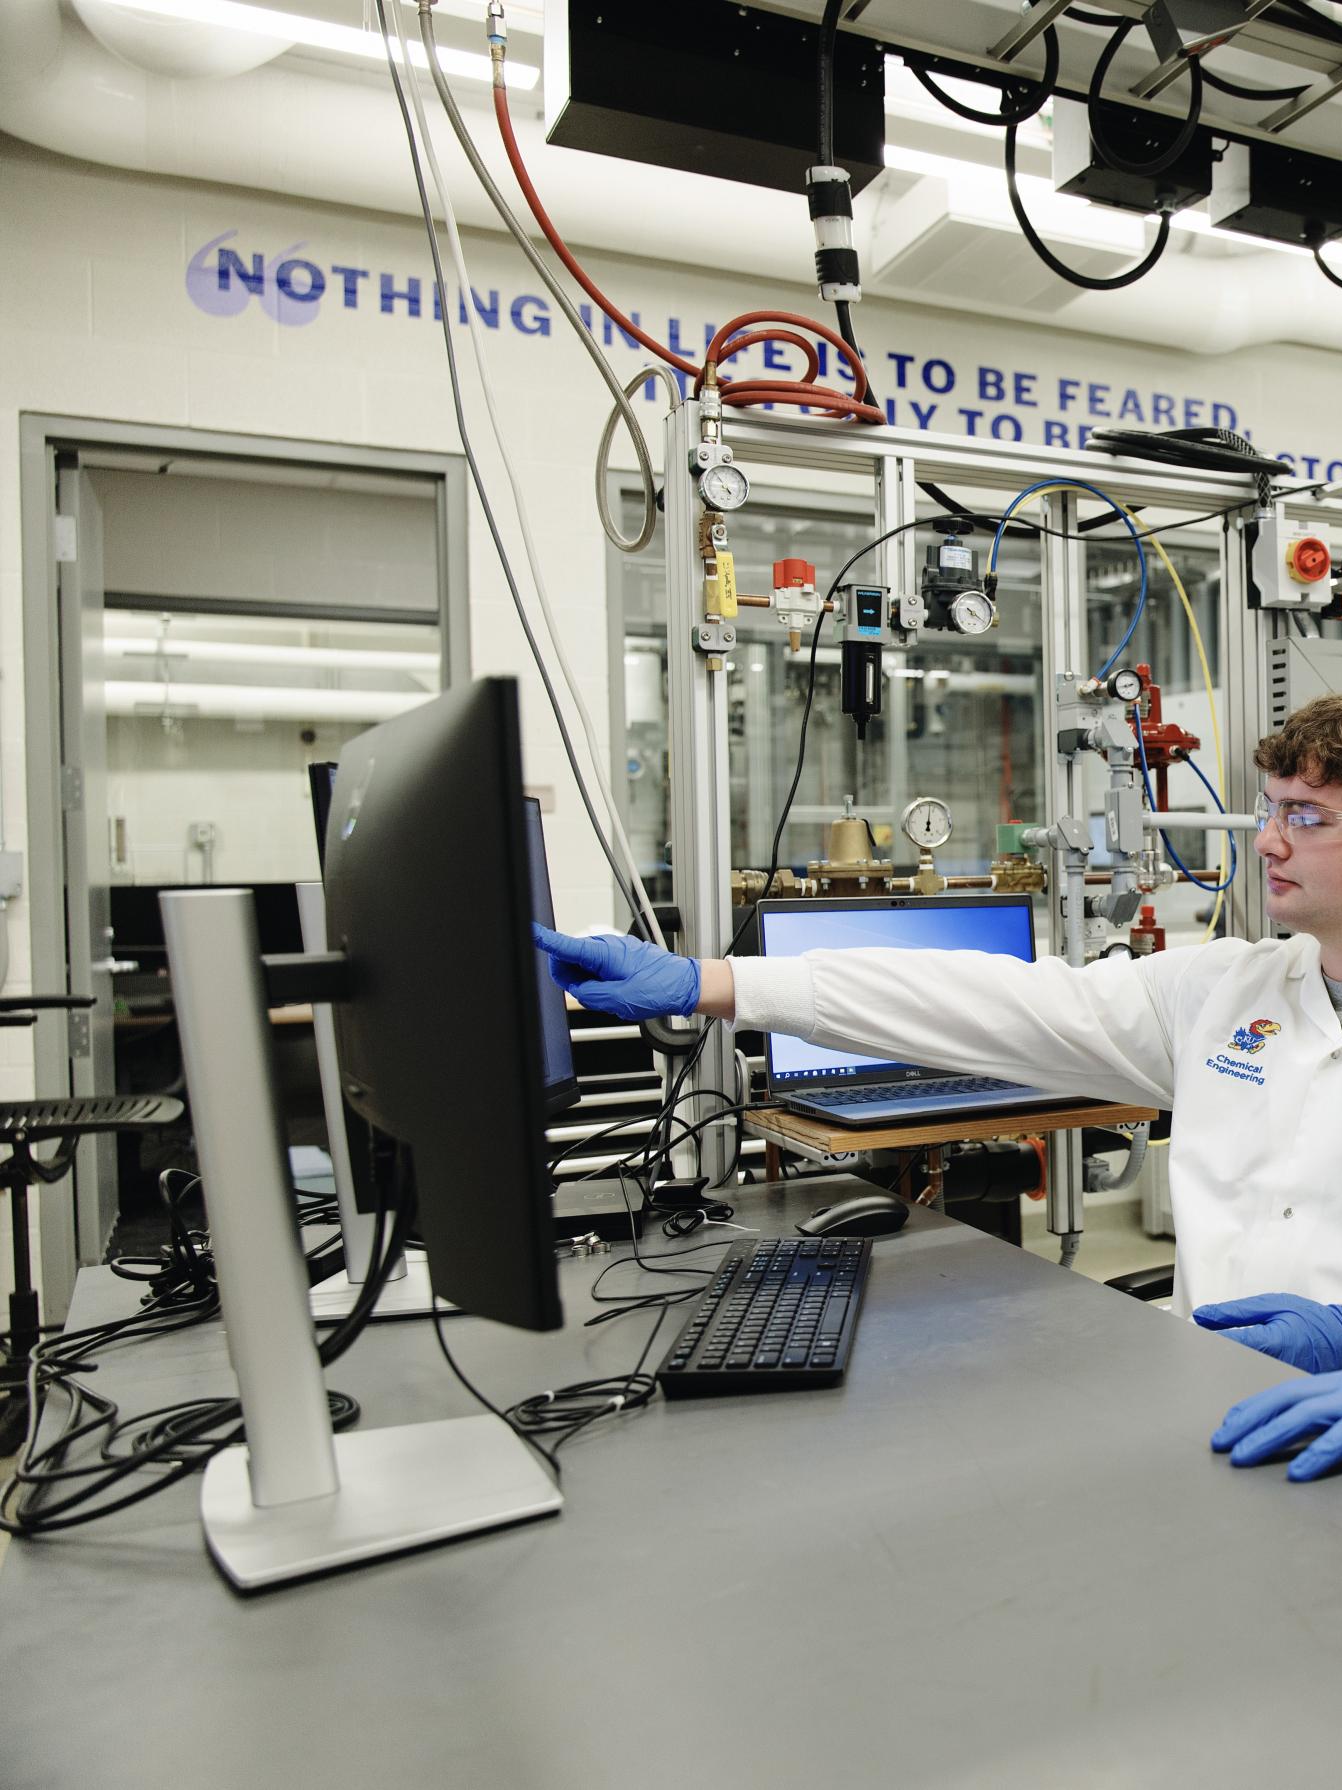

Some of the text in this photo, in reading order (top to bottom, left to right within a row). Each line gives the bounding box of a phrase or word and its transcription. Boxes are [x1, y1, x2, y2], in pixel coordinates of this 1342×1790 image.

[217, 248, 552, 338] NOTHING
[580, 304, 640, 349] IN
[668, 319, 792, 372] LIFE
[888, 353, 955, 393] TO
[978, 367, 1037, 407] BE
[1059, 378, 1252, 442] FEARED,
[958, 408, 1022, 442] TO
[905, 1070, 921, 1078] DELL
[1206, 1058, 1266, 1086] Engineering
[1216, 1054, 1264, 1074] Chemical
